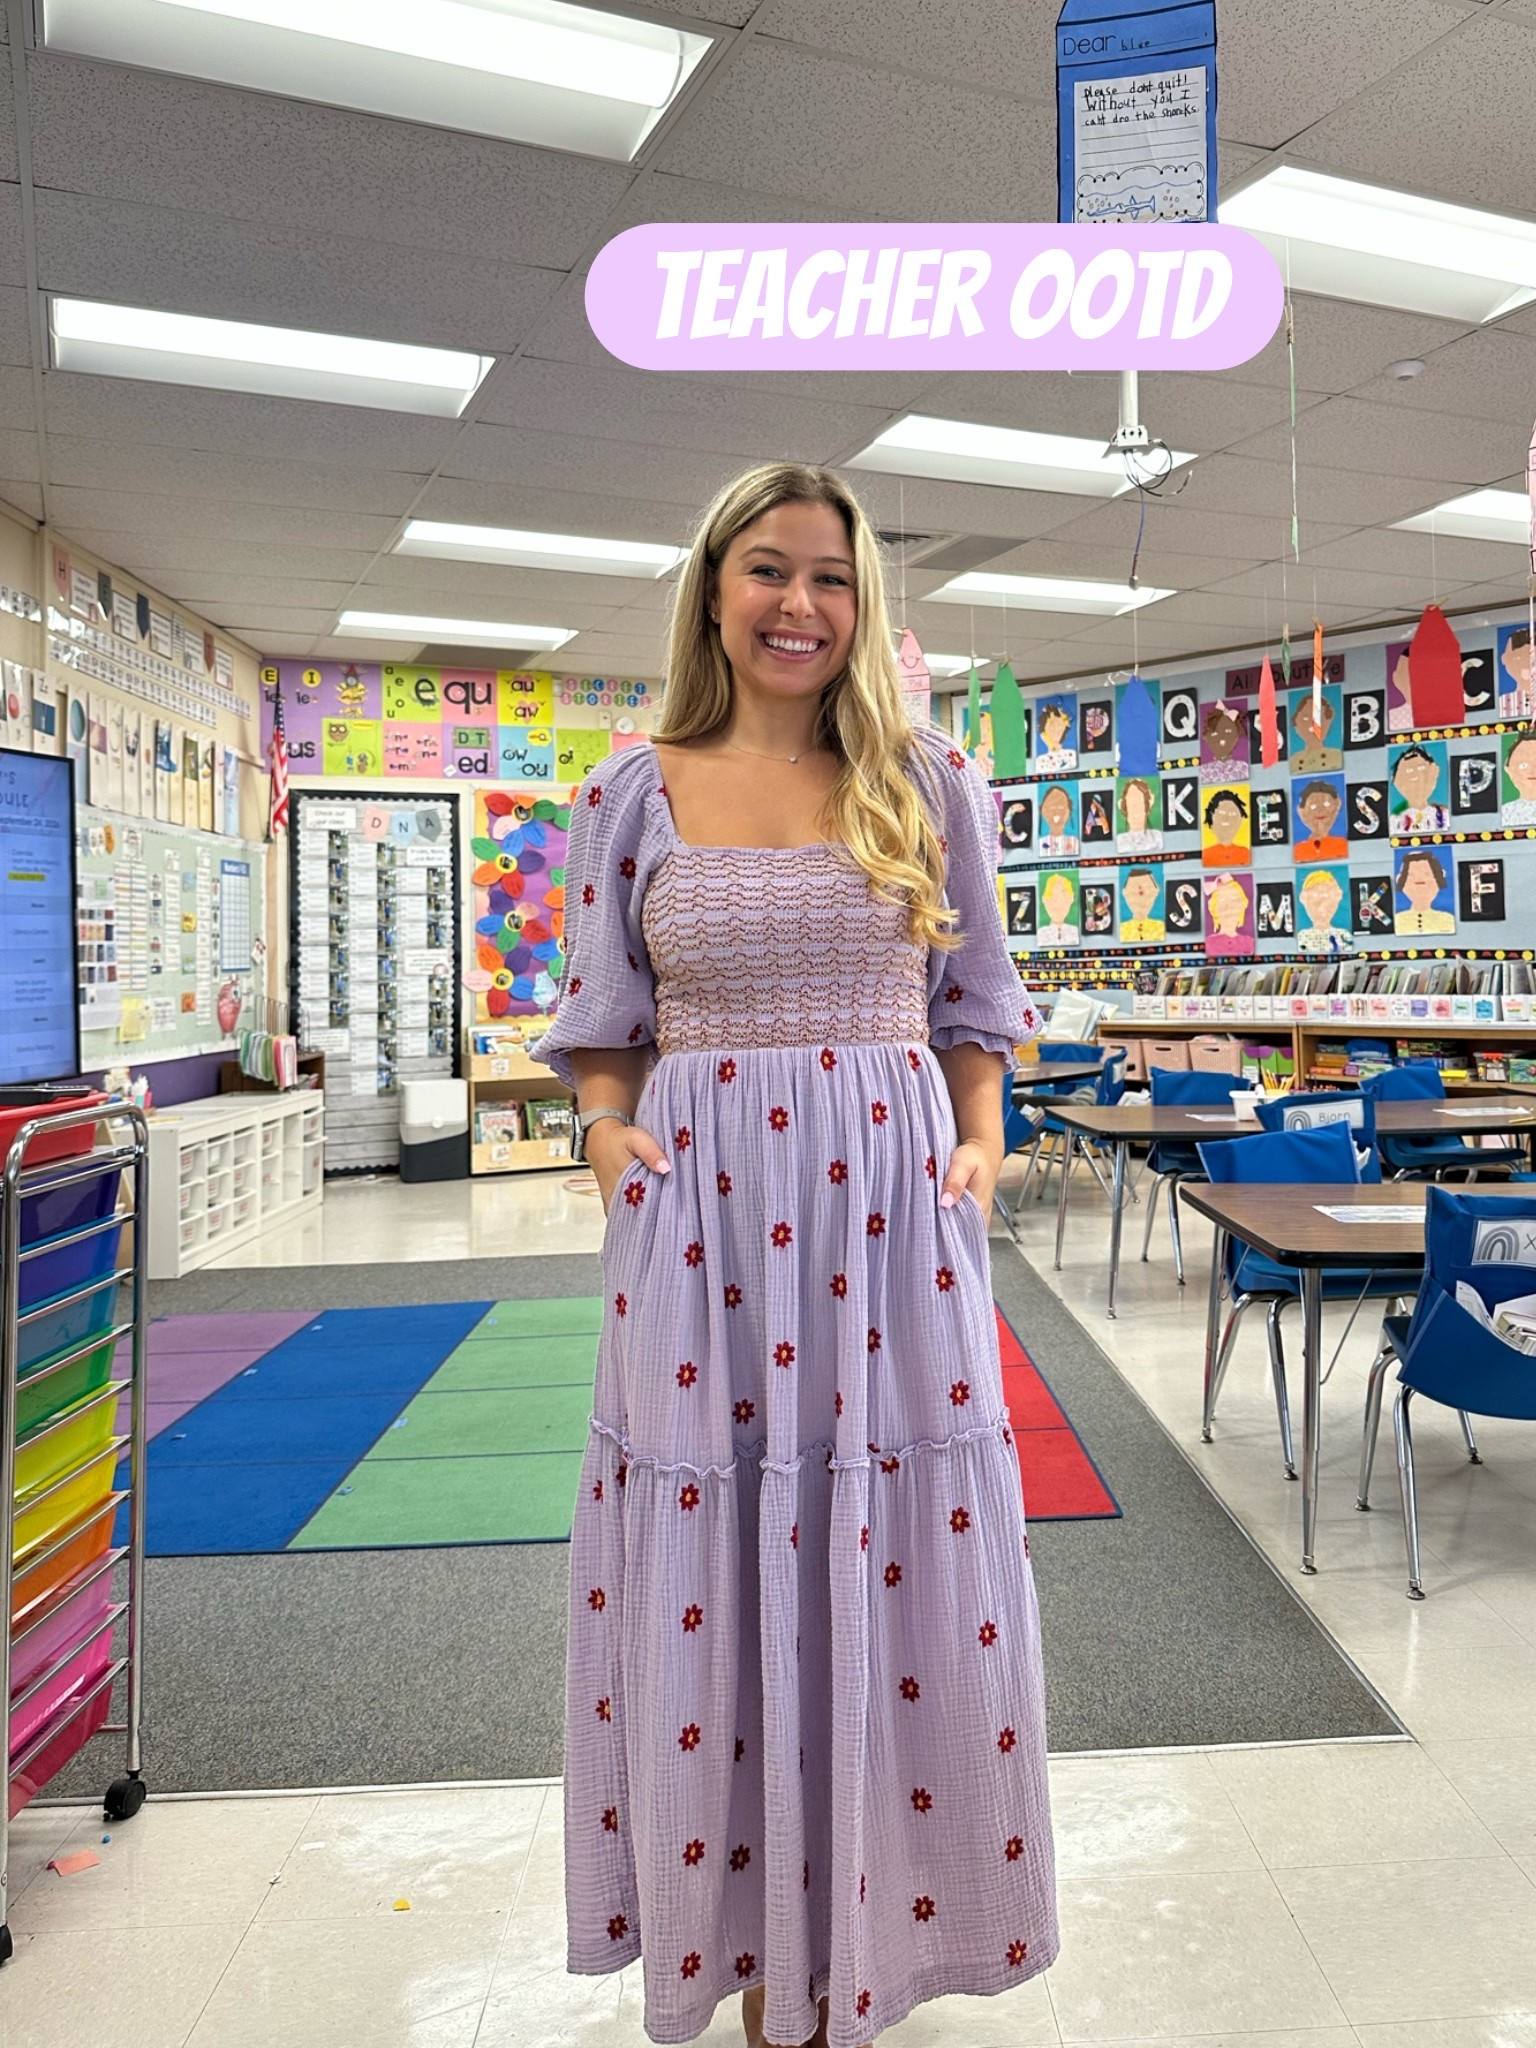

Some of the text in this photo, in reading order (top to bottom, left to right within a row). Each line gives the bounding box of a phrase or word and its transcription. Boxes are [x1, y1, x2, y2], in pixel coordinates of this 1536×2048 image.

[1063, 35, 1117, 56] Dear
[1150, 92, 1173, 109] you
[1181, 89, 1191, 100] I
[1135, 110, 1156, 121] the
[265, 669, 316, 684] E I
[395, 677, 404, 686] e
[511, 679, 535, 692] au
[395, 698, 405, 708] o
[444, 681, 492, 715] qu
[1086, 657, 1491, 750] P Q B C
[514, 706, 539, 718] aw
[458, 732, 485, 744] D T
[502, 748, 528, 761] ow
[458, 753, 488, 774] ed
[522, 763, 548, 777] ou
[1004, 758, 1496, 843] C A K E S P
[371, 817, 435, 833] D N A
[1009, 862, 1499, 933] Z B S M K F
[1319, 1112, 1351, 1124] Bjorn
